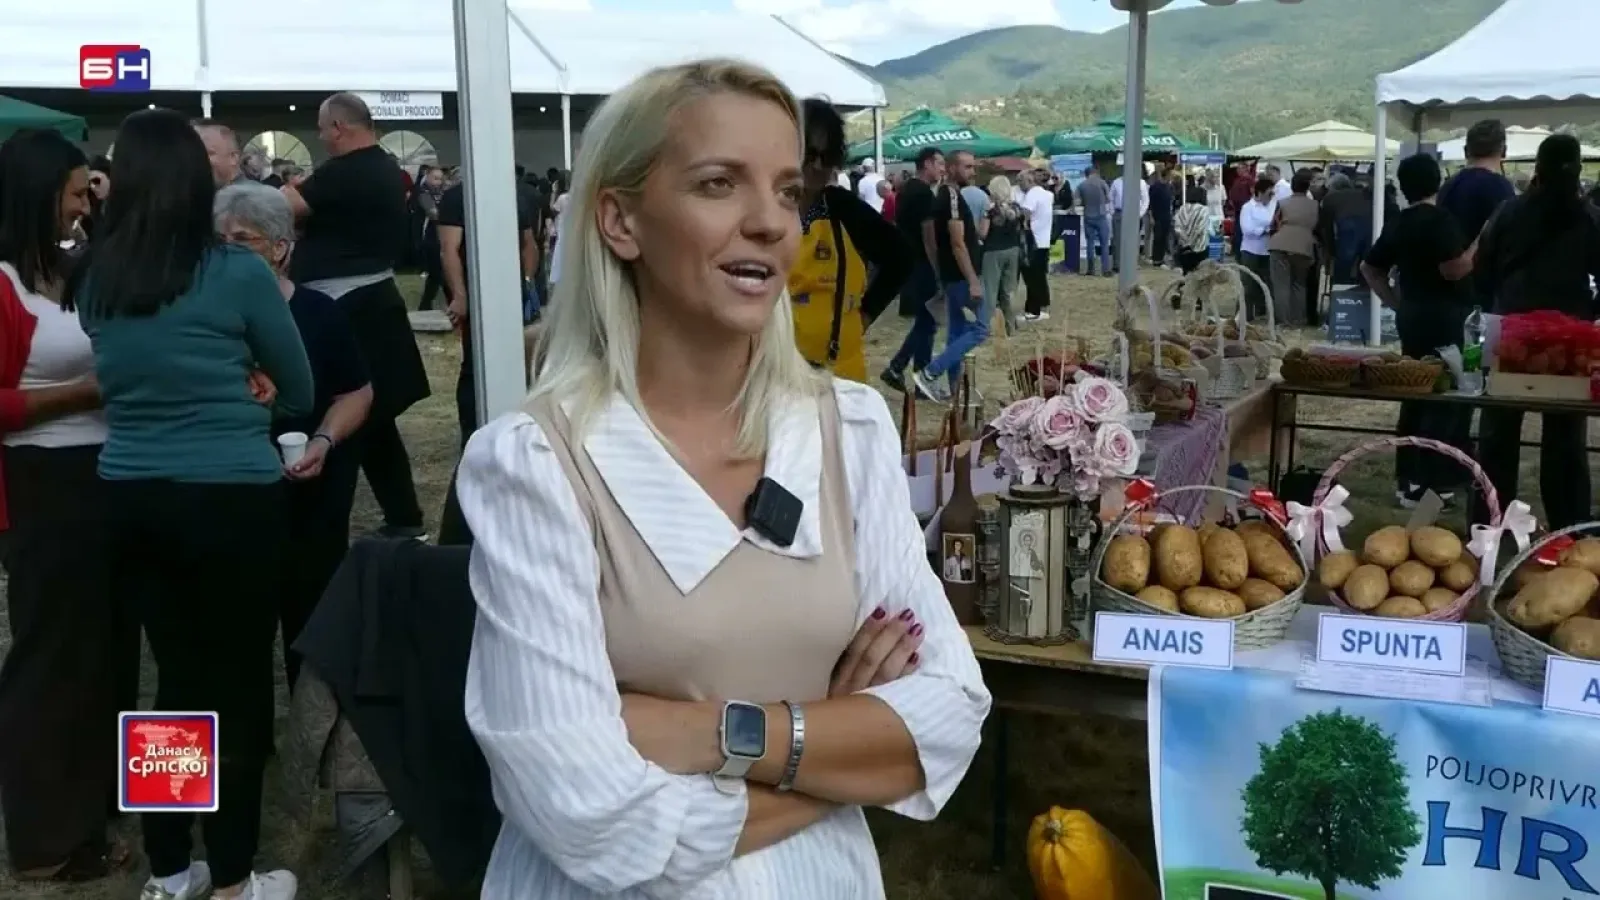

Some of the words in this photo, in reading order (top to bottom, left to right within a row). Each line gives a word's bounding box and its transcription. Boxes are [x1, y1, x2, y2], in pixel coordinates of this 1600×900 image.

[1111, 135, 1176, 147] vnka
[1122, 626, 1204, 655] ANAIS
[1339, 627, 1443, 661] SPUNTA
[1426, 754, 1597, 809] POLJOPRIVR
[1422, 800, 1600, 896] HR
